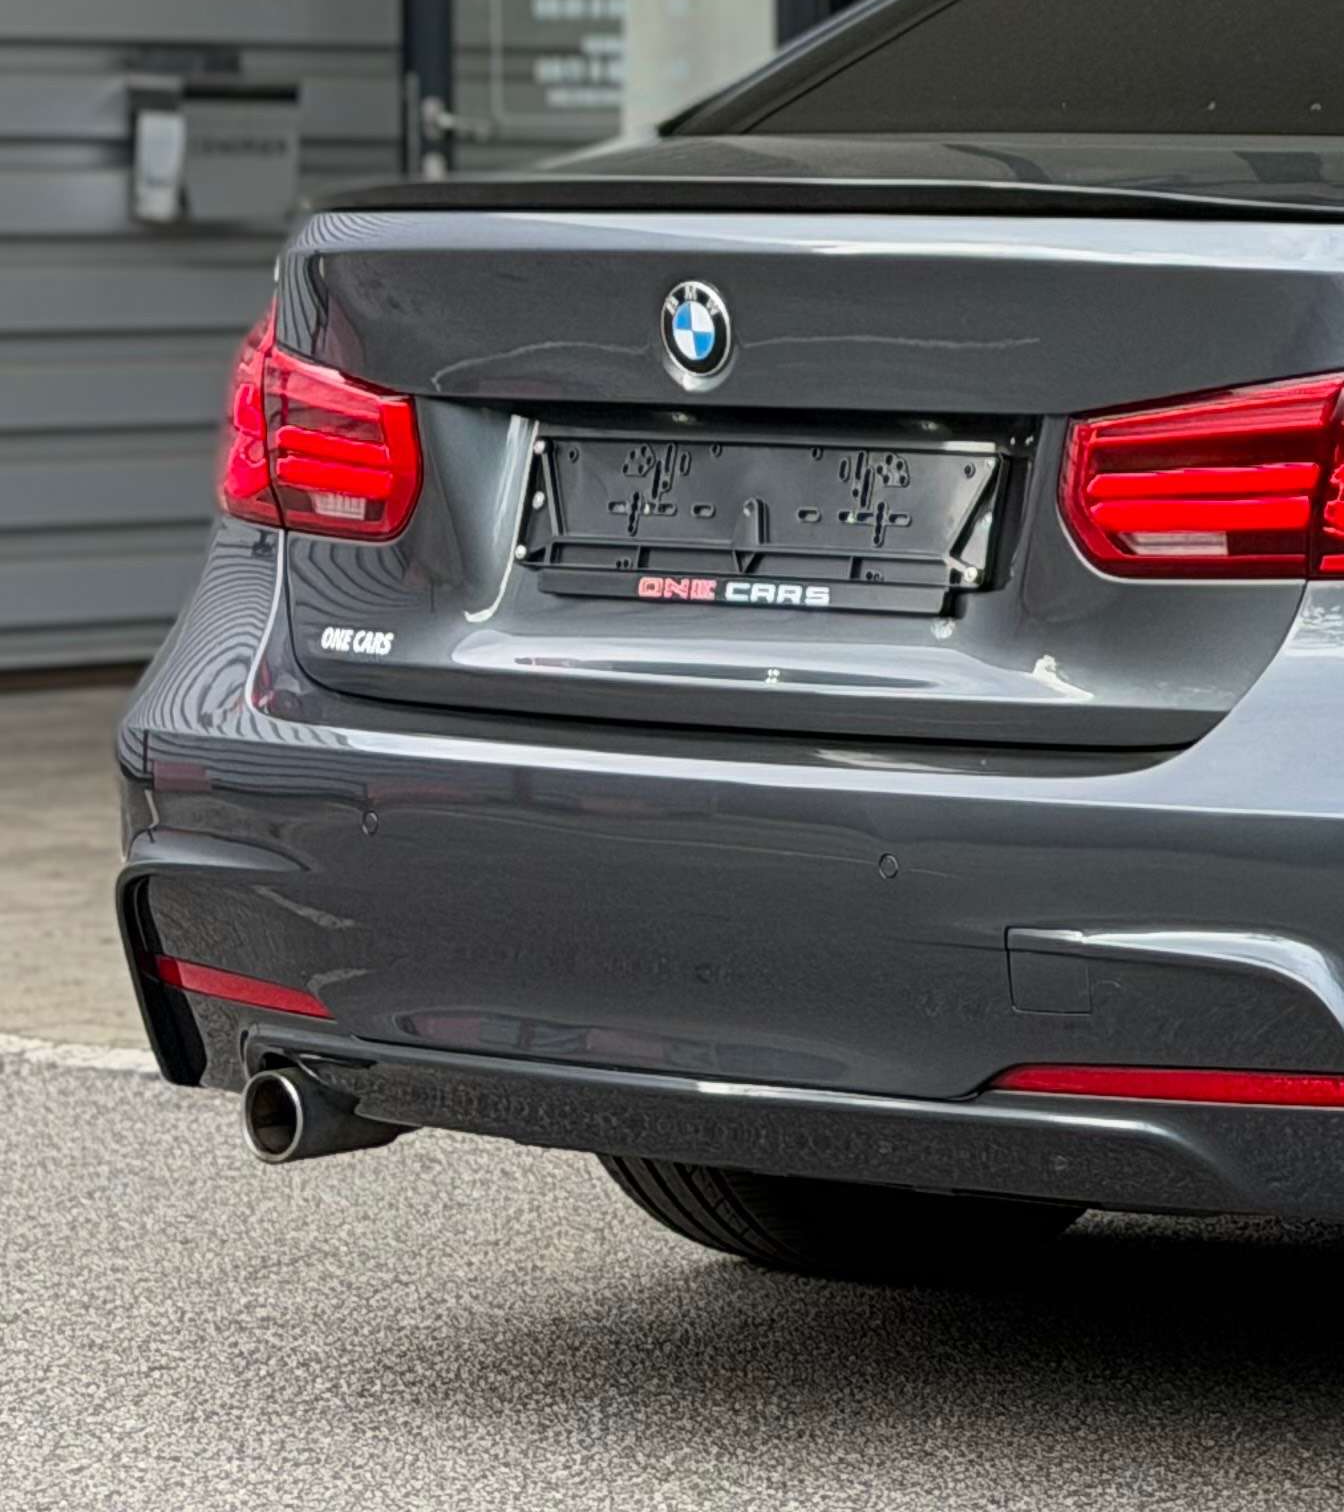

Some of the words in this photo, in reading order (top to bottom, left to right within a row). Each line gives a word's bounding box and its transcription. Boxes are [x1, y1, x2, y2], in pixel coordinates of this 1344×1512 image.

[665, 286, 721, 316] BMW
[638, 576, 717, 600] ONE
[725, 581, 830, 607] CARS
[321, 626, 354, 652] ONE
[353, 630, 395, 656] CARS
